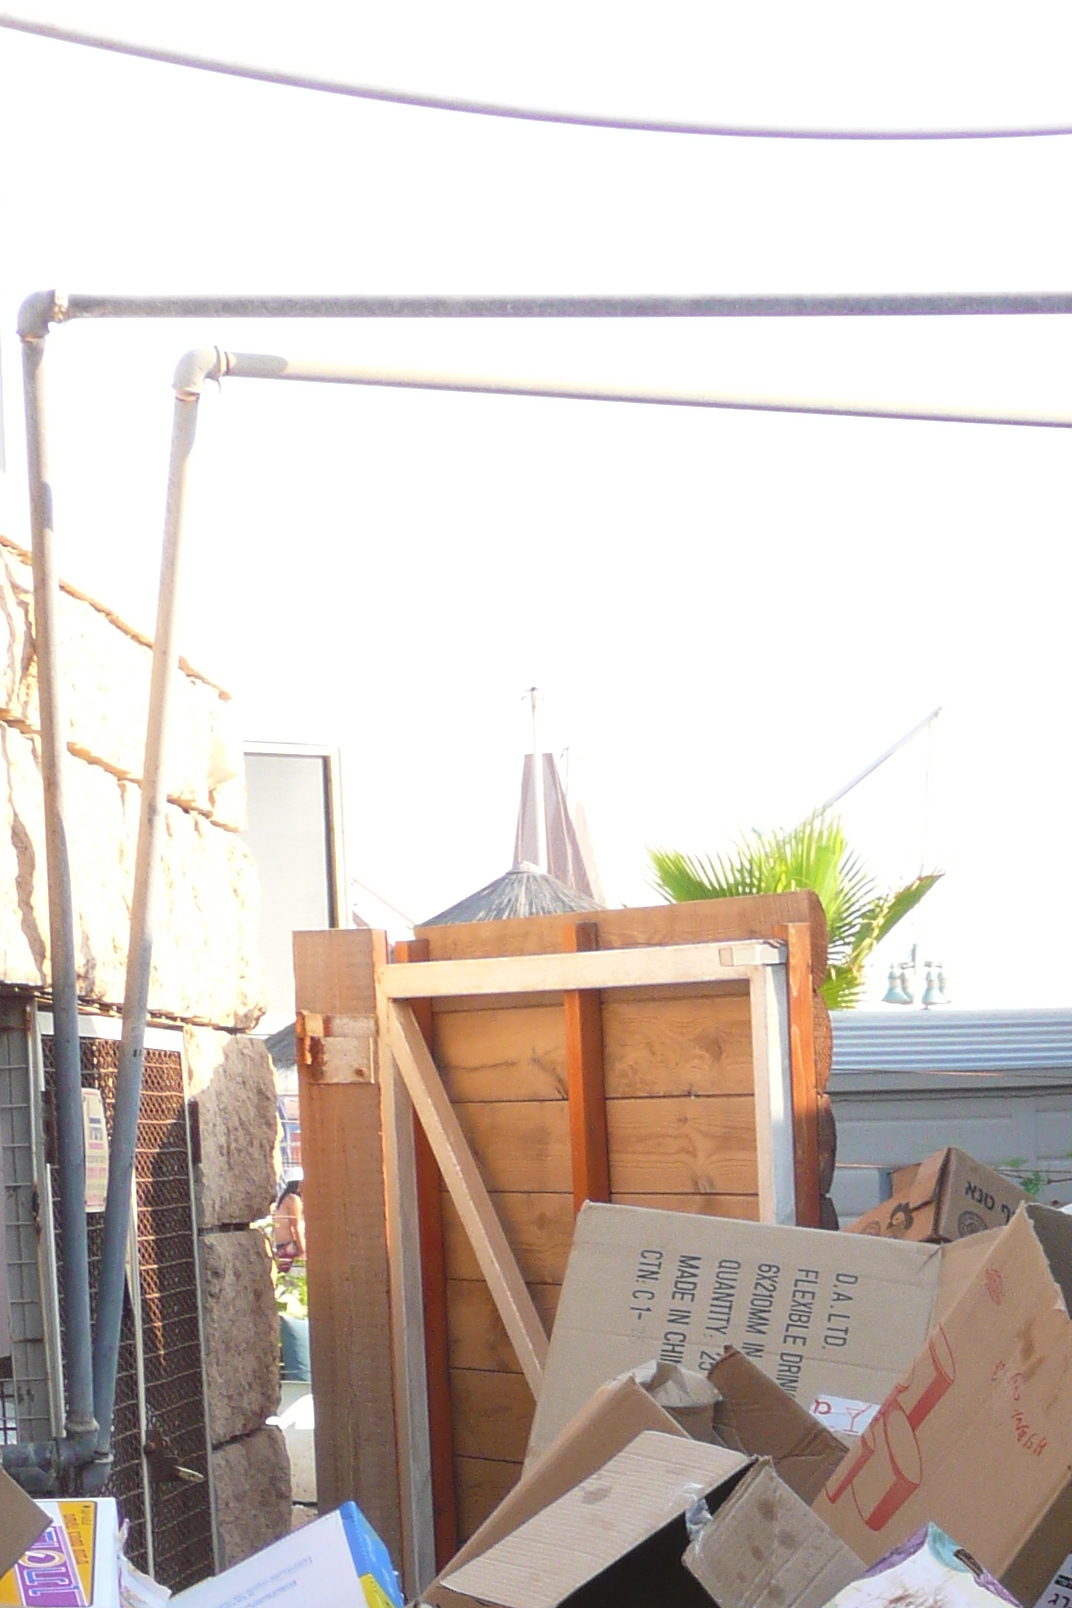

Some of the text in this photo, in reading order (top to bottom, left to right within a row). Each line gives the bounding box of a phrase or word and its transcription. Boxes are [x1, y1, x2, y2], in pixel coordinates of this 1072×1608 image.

[635, 1249, 664, 1283] CTN:
[671, 1254, 702, 1303] MADE
[666, 1306, 692, 1326] IN
[745, 1262, 780, 1336] 6X210MM
[782, 1268, 819, 1347] FLEXIBLE
